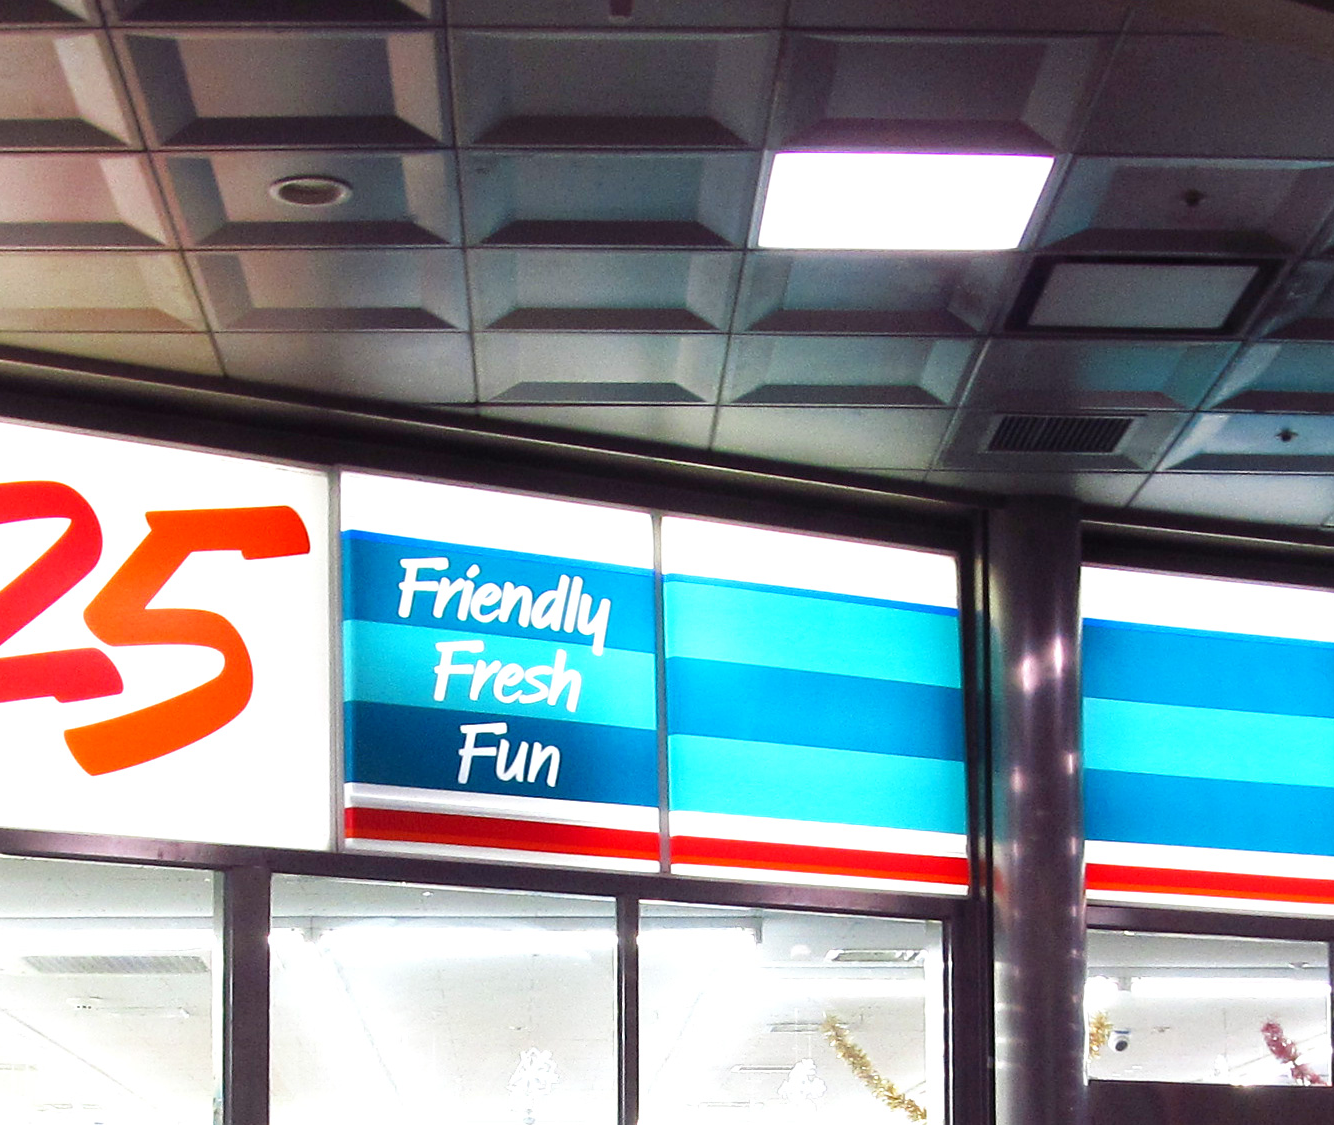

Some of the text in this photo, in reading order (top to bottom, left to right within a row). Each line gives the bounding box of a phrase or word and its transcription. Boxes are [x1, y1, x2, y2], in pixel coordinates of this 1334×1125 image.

[396, 556, 612, 656] Friendly
[432, 640, 583, 713] Fresh
[457, 722, 562, 788] Fun
